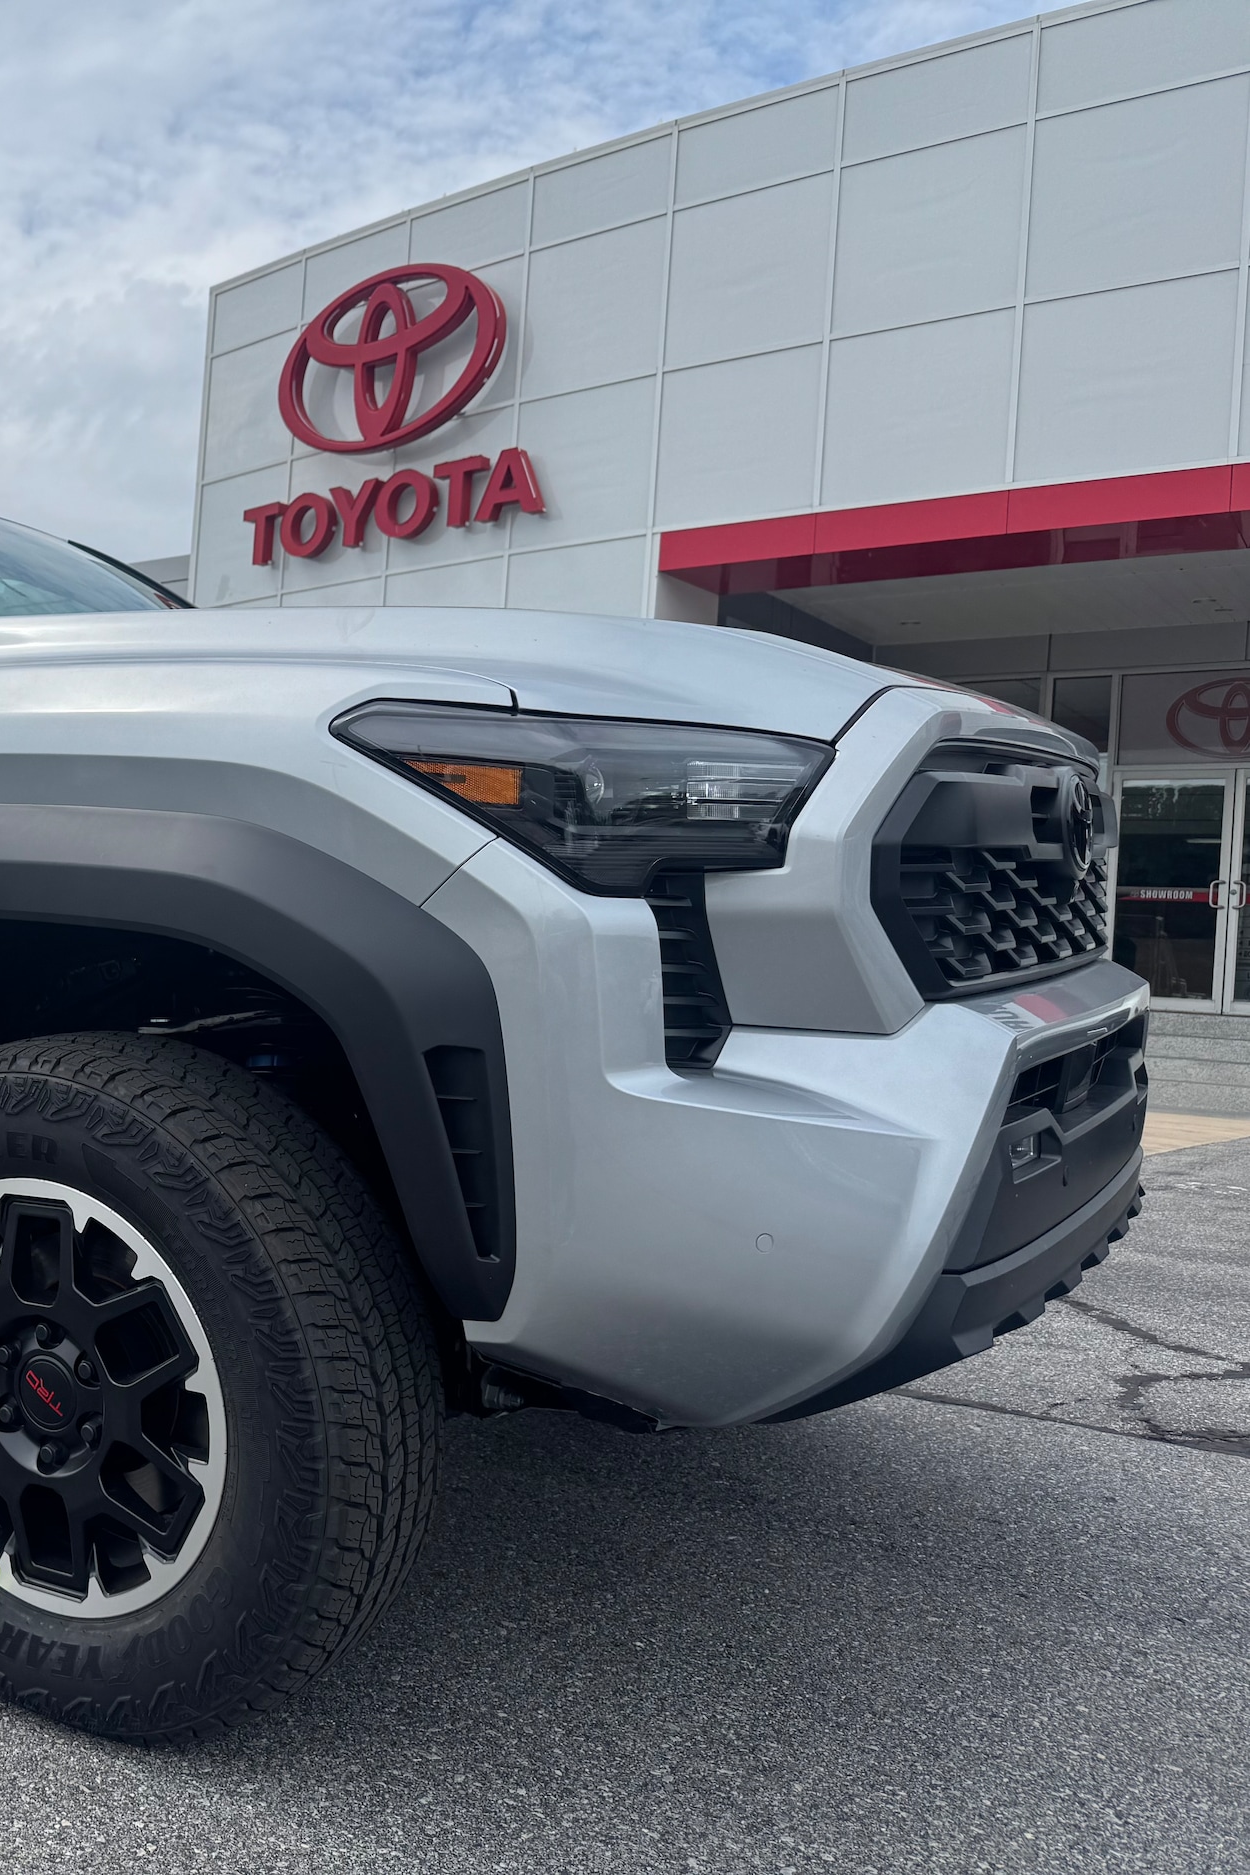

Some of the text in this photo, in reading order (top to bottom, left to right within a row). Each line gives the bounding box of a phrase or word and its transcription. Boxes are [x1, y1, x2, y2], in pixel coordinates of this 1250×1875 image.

[243, 447, 546, 566] TOYOTA
[1140, 889, 1193, 900] SHOWROOM
[25, 1369, 64, 1417] TRD
